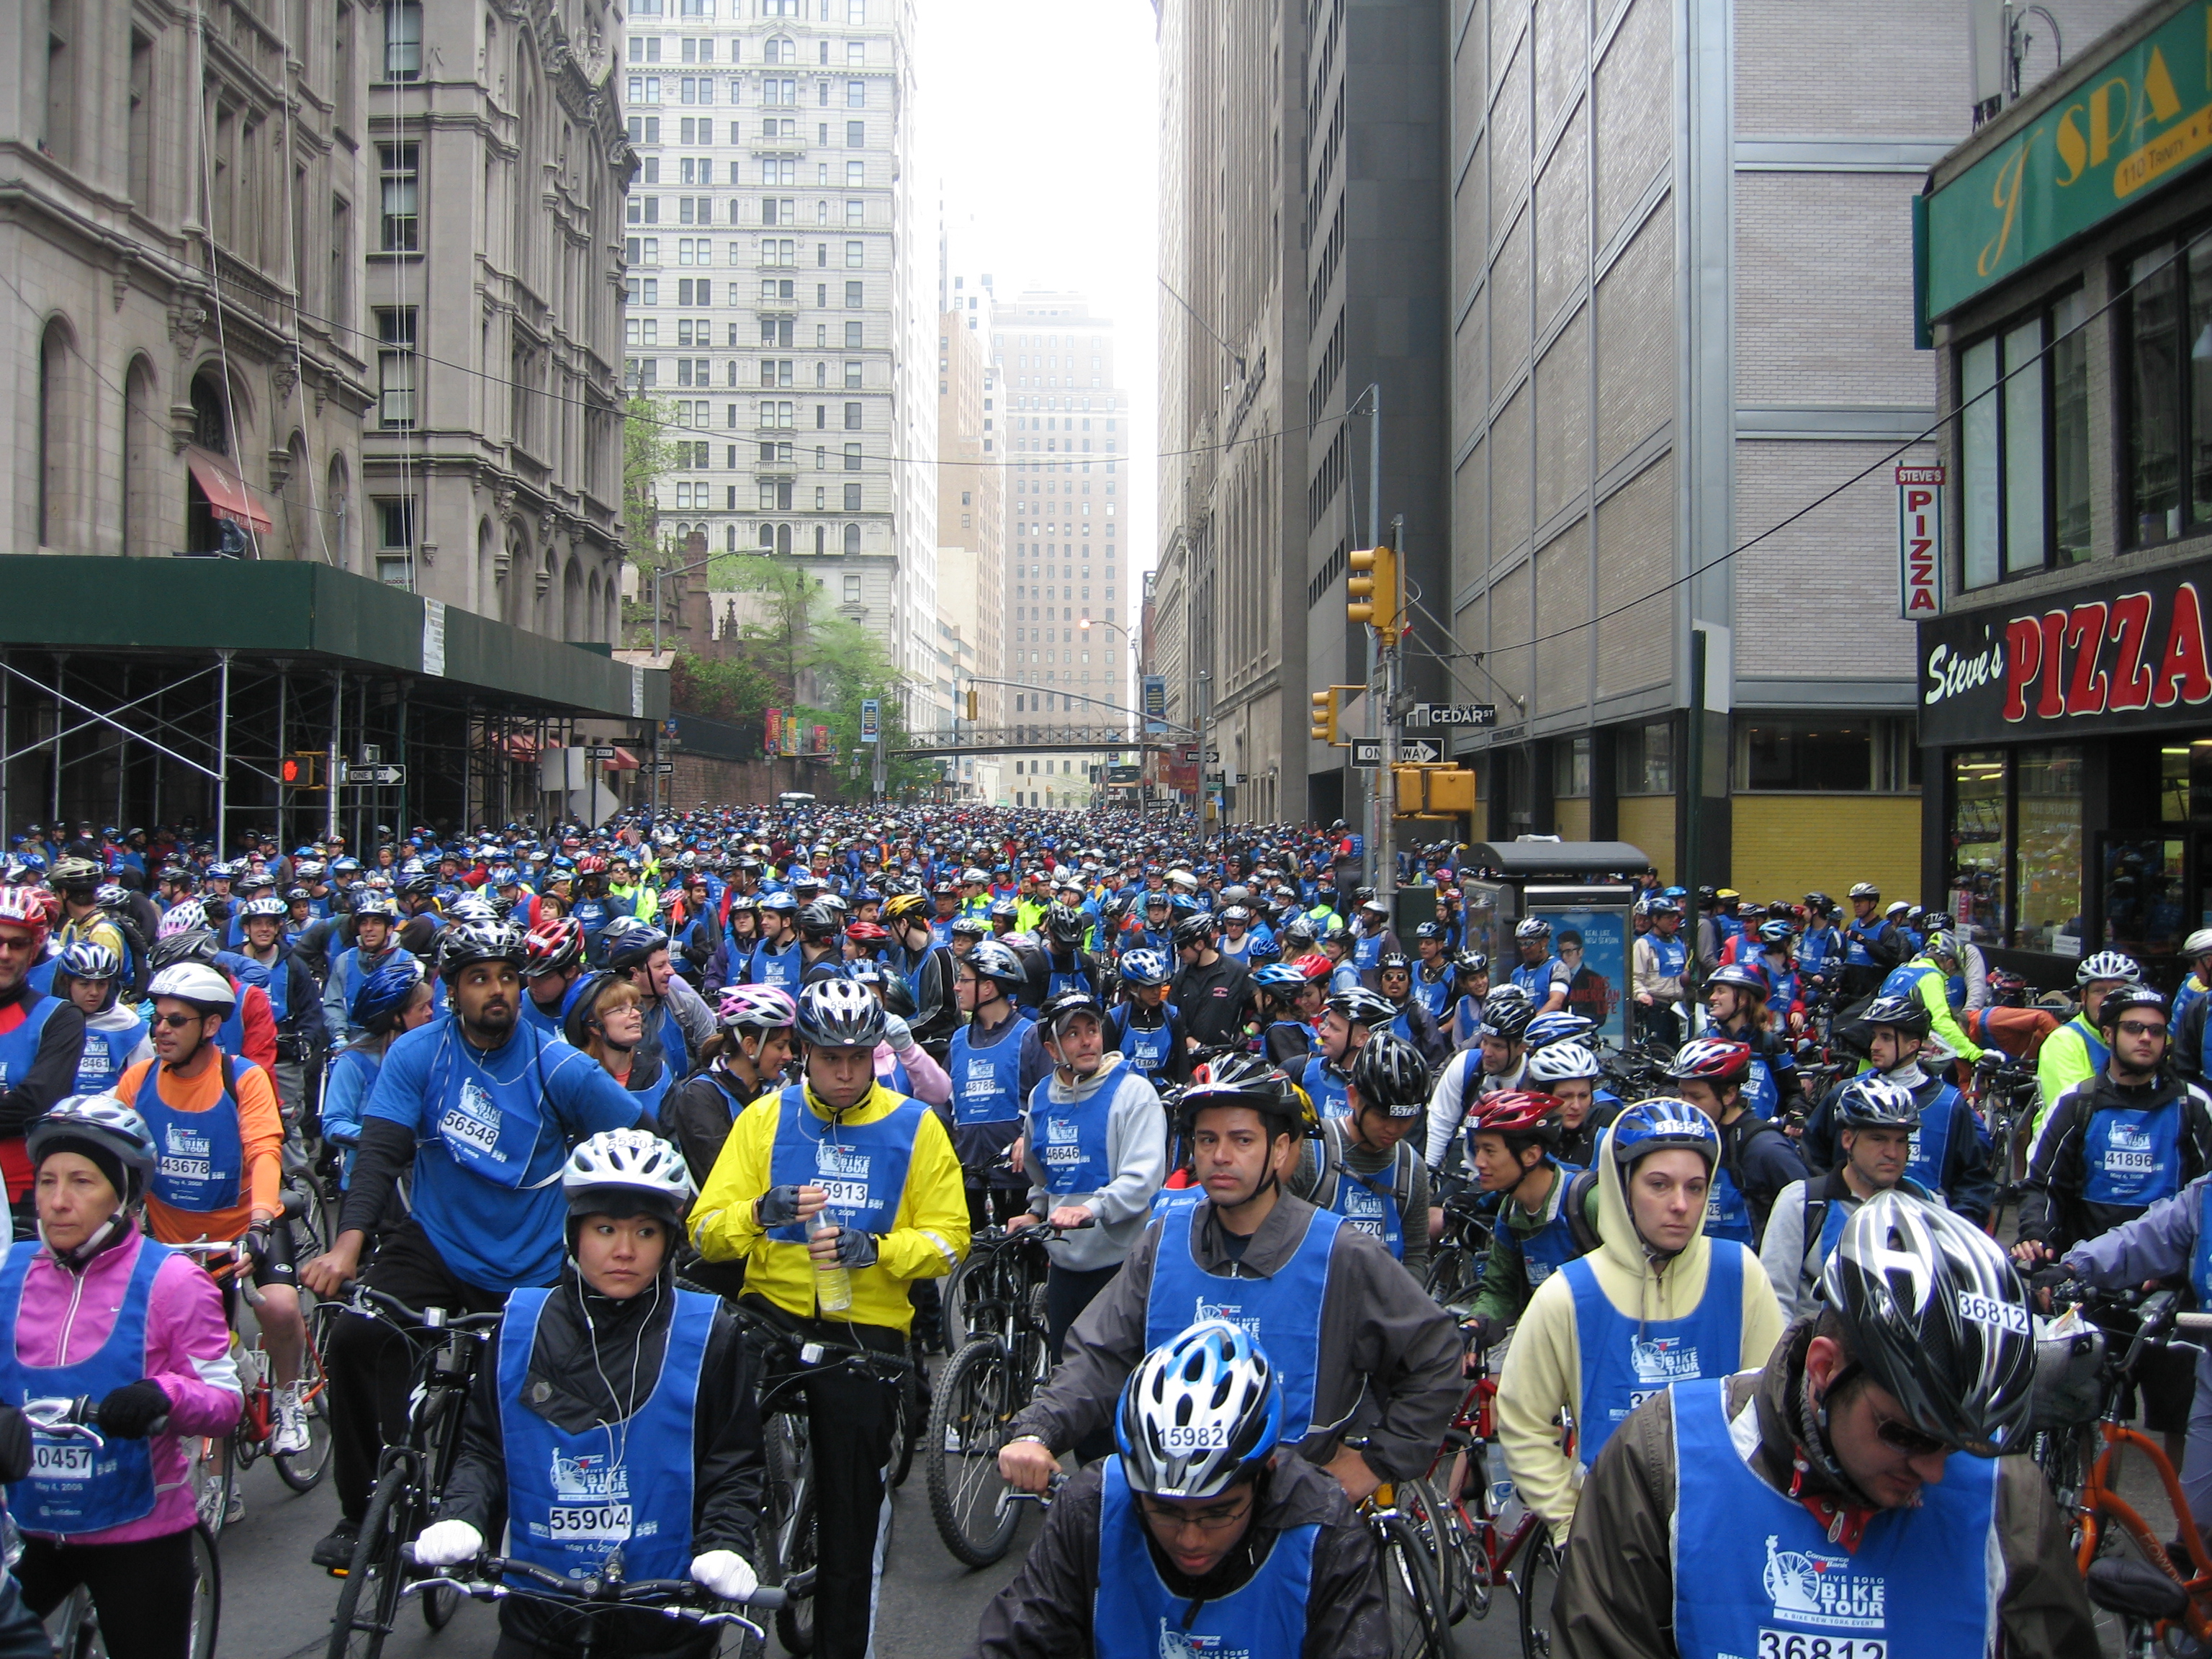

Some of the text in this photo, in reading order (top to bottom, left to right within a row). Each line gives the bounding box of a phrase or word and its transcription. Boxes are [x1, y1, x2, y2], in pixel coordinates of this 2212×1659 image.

[2056, 45, 2181, 186] SPA
[1899, 469, 1942, 482] STEVE'S
[1908, 490, 1936, 610] PIZZA
[1925, 581, 2212, 723] Steve's PIZZA
[1431, 710, 1483, 723] CEDAR
[1364, 747, 1429, 759] ON WAY
[1570, 989, 1619, 1001] AMERICAN
[81, 1058, 109, 1068] 8461
[444, 1111, 497, 1146] 56548
[1656, 1120, 1704, 1136] 31955
[1046, 1146, 1079, 1160] 46646
[2106, 1152, 2152, 1166] 41896
[162, 1158, 209, 1174] 43678
[840, 1158, 871, 1168] BIKE
[840, 1165, 869, 1174] TOUR
[1352, 1221, 1382, 1236] 720
[1959, 1293, 2027, 1332] 36812
[1665, 1351, 1698, 1367] BIKE
[1666, 1362, 1700, 1375] TOUR
[1156, 1426, 1223, 1447] 15982
[33, 1447, 91, 1469] 0457
[587, 1470, 628, 1485] BIKE
[587, 1481, 629, 1494] TOUR
[1157, 1487, 1186, 1496] GIRO
[550, 1506, 631, 1530] 55904
[1805, 1550, 1850, 1563] Commerce
[1821, 1574, 1884, 1584] FIVE BORO
[1821, 1583, 1885, 1602] BIKE
[1820, 1599, 1885, 1617] TOUR
[1791, 1613, 1809, 1622] BIKE
[1829, 1617, 1849, 1626] YORK
